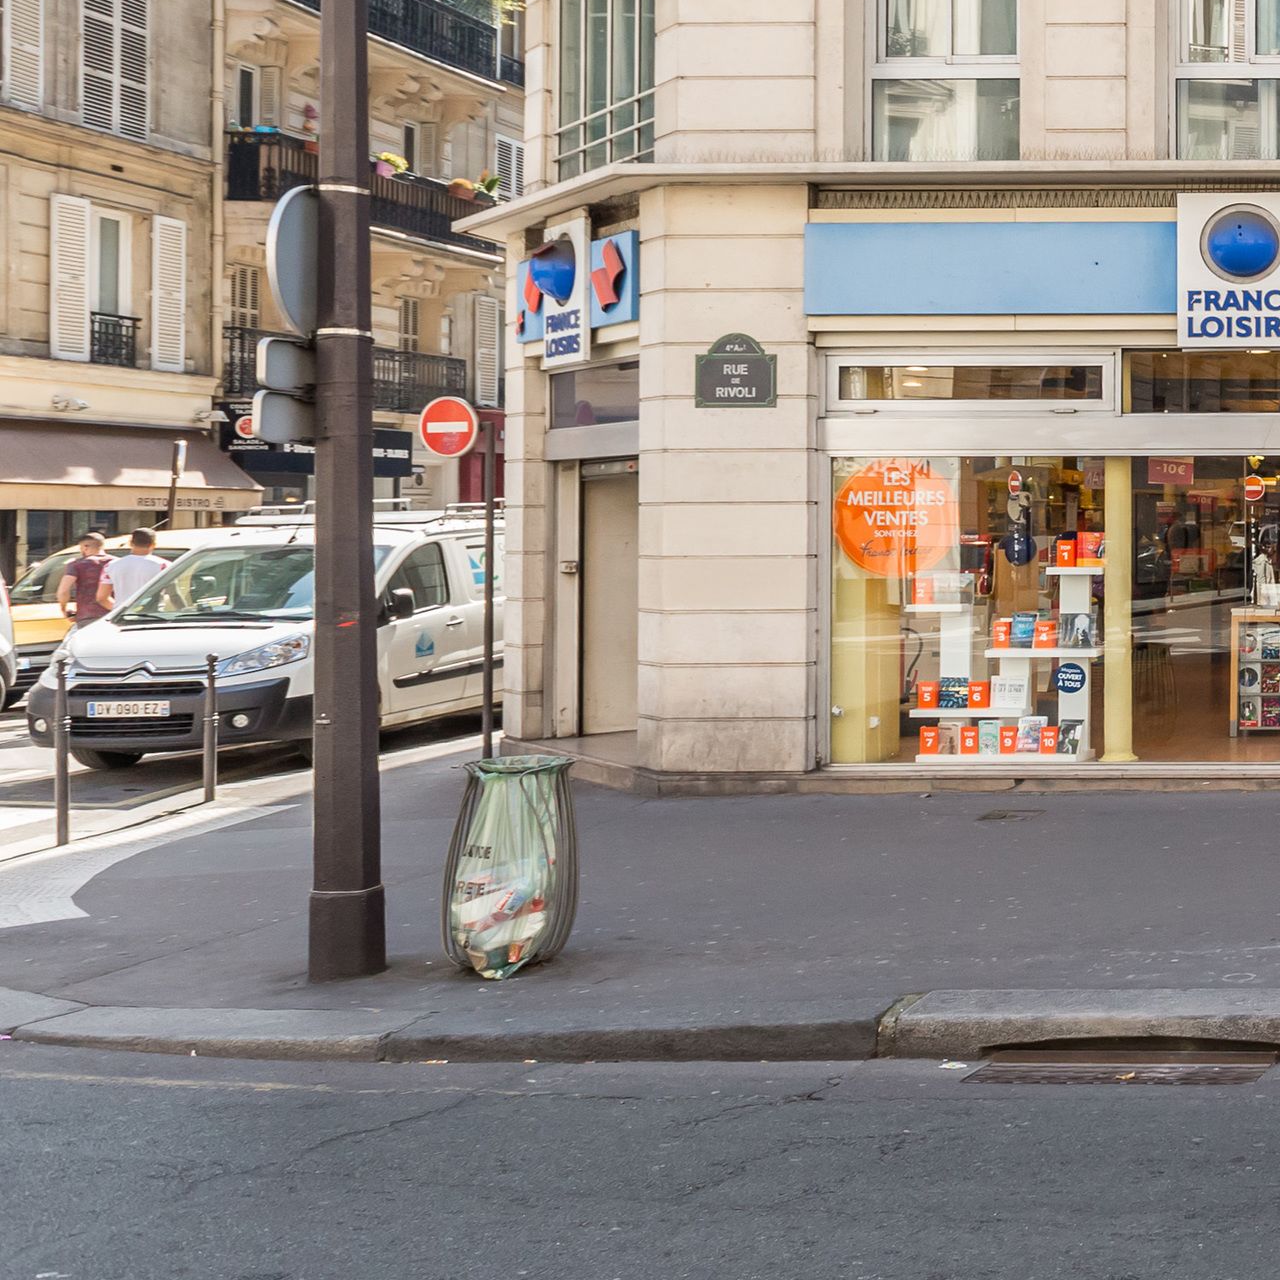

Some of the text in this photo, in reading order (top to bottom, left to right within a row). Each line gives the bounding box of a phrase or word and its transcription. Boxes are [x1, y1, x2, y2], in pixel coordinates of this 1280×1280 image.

[545, 308, 581, 334] FRANCE
[545, 333, 581, 358] LOISIRS
[723, 364, 749, 375] RUE
[715, 387, 756, 398] RIVOLI
[883, 470, 911, 486] LES
[137, 497, 210, 508] RESTO BISTRO
[847, 490, 945, 506] MEILLEURES
[863, 510, 929, 526] VENTES
[874, 529, 920, 538] SONT CHEZ
[1062, 552, 1069, 560] 1
[917, 589, 925, 597] 2
[998, 633, 1005, 641] 3
[1039, 633, 1048, 641] 4
[923, 693, 931, 701] 5
[973, 693, 981, 701] 6
[925, 738, 933, 747] 7
[965, 738, 974, 747] 8
[1004, 738, 1012, 747] 9
[1043, 738, 1055, 747] 10
